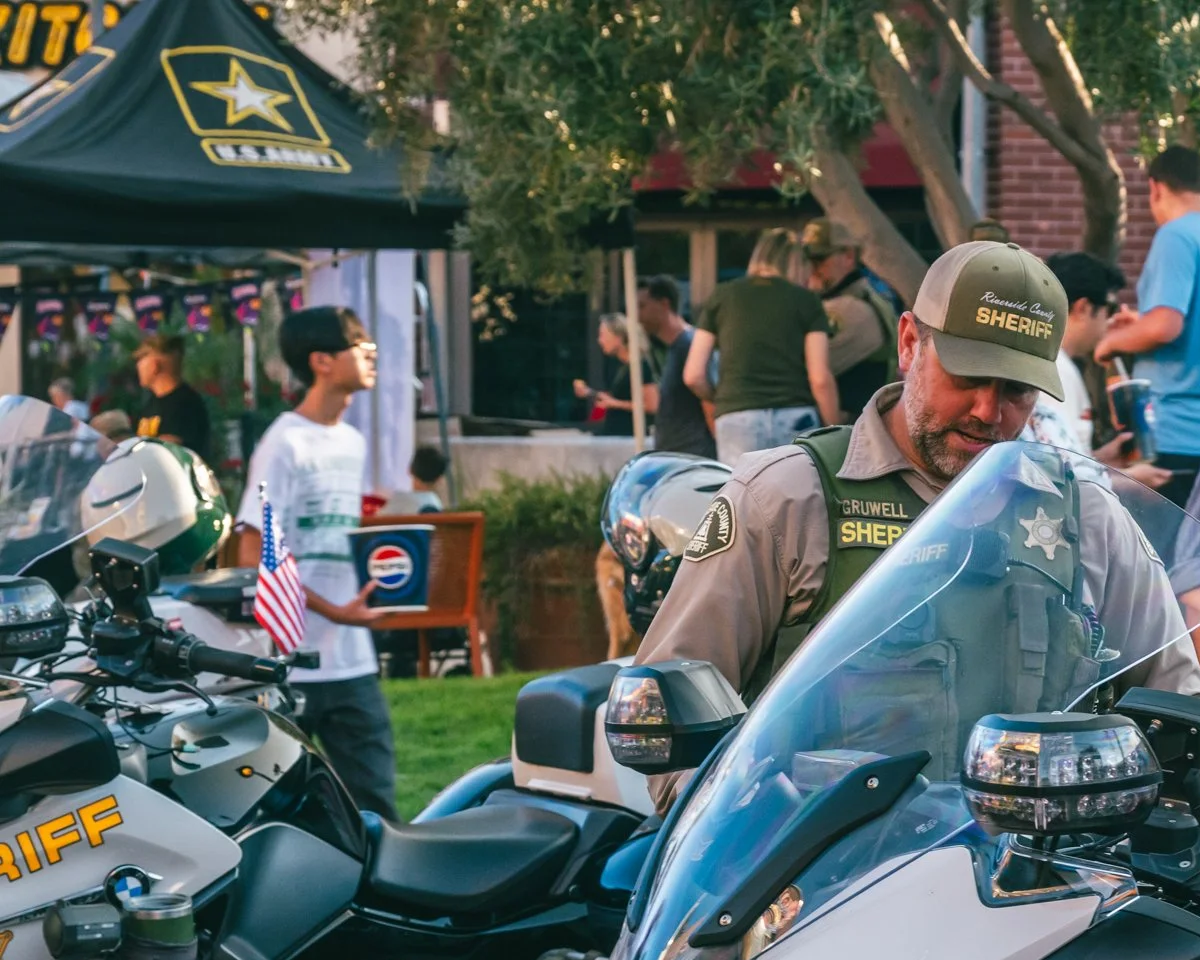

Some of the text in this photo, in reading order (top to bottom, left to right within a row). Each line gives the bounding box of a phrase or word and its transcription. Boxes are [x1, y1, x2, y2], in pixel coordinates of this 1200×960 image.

[975, 306, 1053, 340] SHERIFF
[980, 291, 1056, 323] Riverside County
[842, 500, 909, 518] GRUWELL
